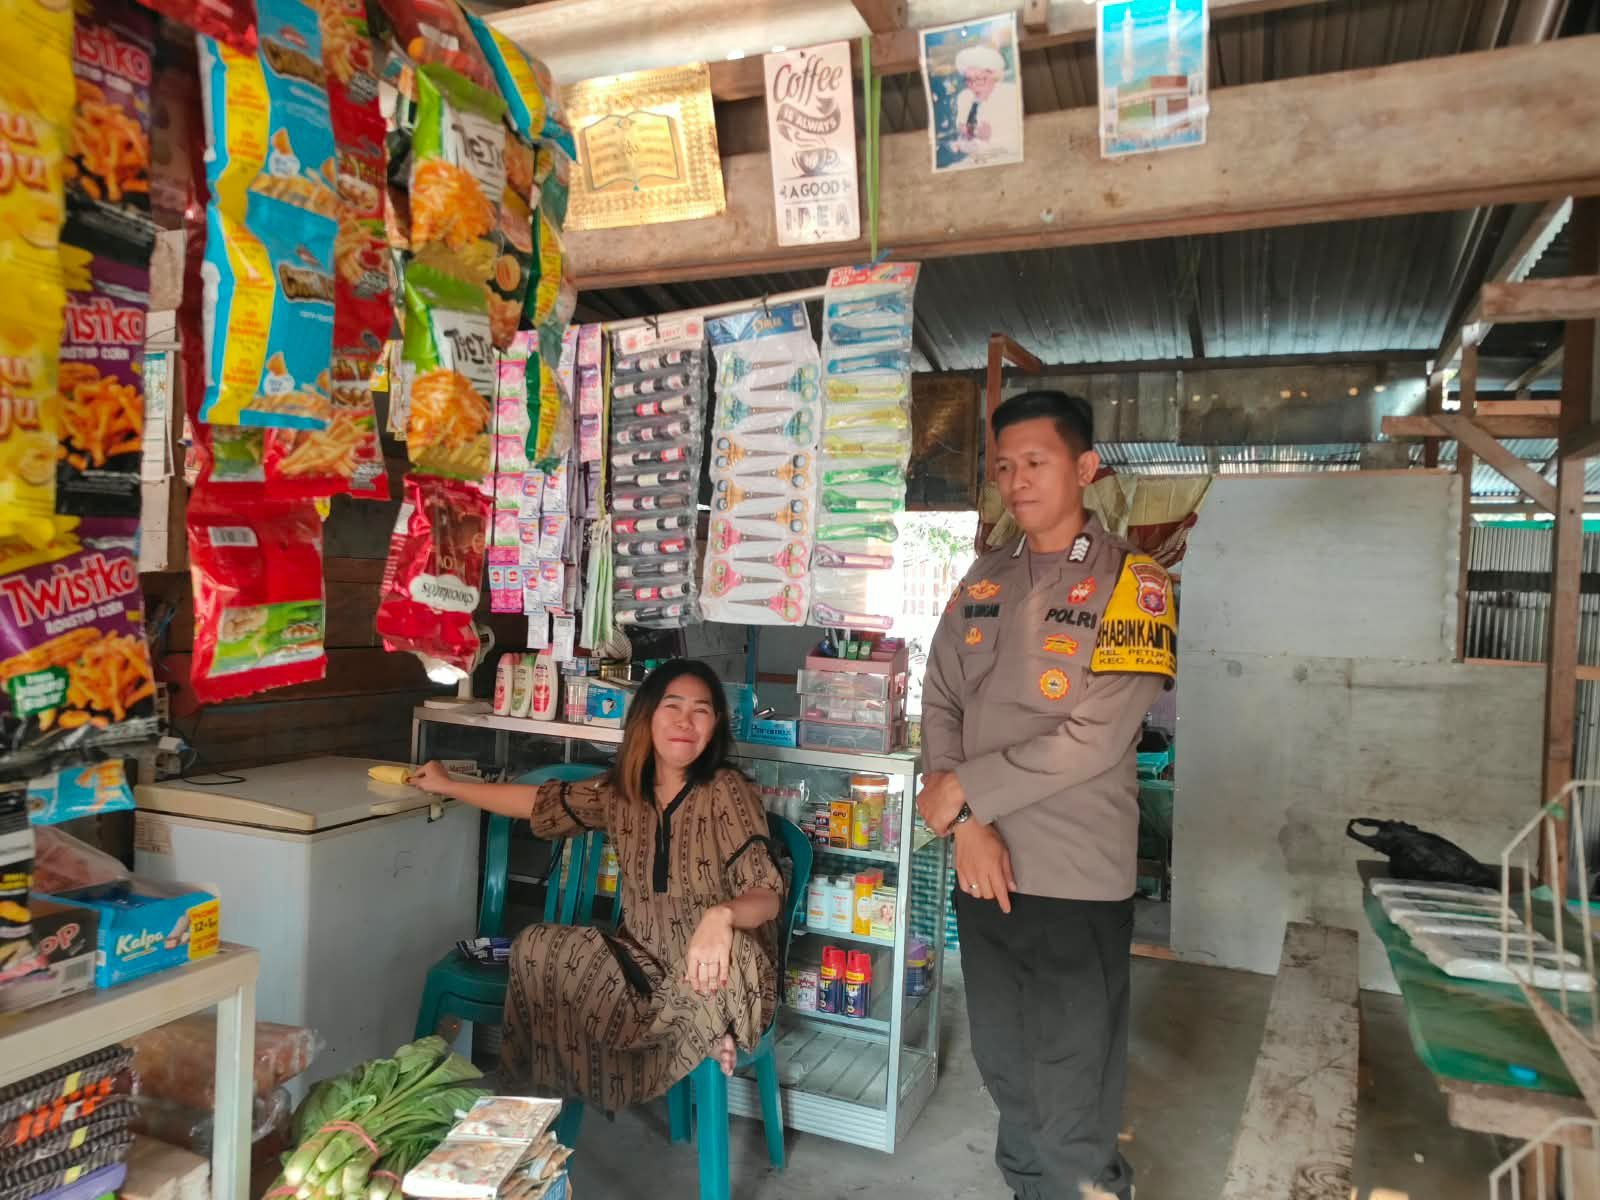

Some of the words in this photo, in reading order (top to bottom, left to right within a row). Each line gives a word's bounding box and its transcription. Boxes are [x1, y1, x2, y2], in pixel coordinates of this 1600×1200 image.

[773, 54, 843, 105] Coffee
[797, 115, 837, 135] ALWAYS
[790, 185, 799, 199] A
[800, 180, 840, 197] GOOD
[0, 553, 139, 627] Twistko
[1044, 607, 1098, 630] POLRI
[832, 810, 847, 818] GPU
[116, 929, 164, 956] Kalpa
